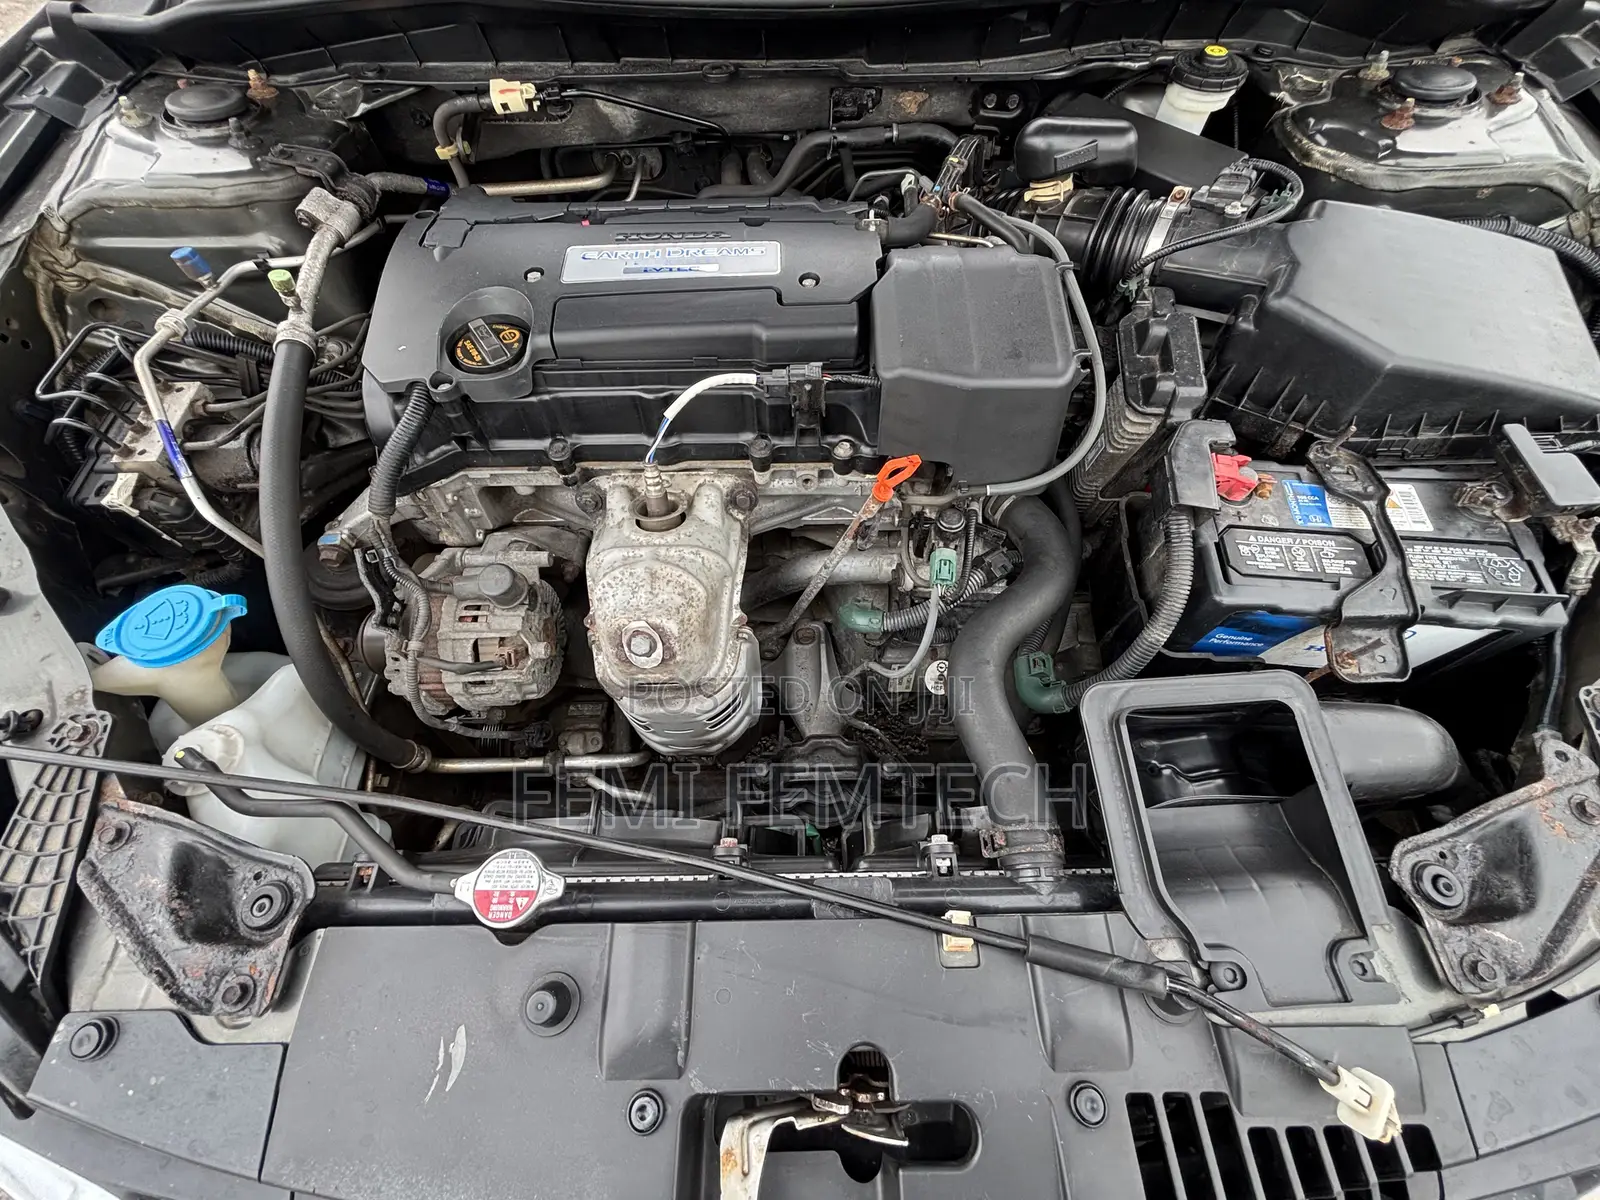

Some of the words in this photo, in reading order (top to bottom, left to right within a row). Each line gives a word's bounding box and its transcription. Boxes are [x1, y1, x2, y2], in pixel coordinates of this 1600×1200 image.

[614, 231, 733, 242] HONDA
[580, 248, 662, 261] EARTH
[664, 246, 767, 259] DREAMS
[1257, 535, 1294, 545] DANGER
[1302, 539, 1336, 548] POISON
[1215, 633, 1254, 642] Genuine
[1208, 638, 1265, 648] Performance
[487, 911, 513, 919] DANGER
